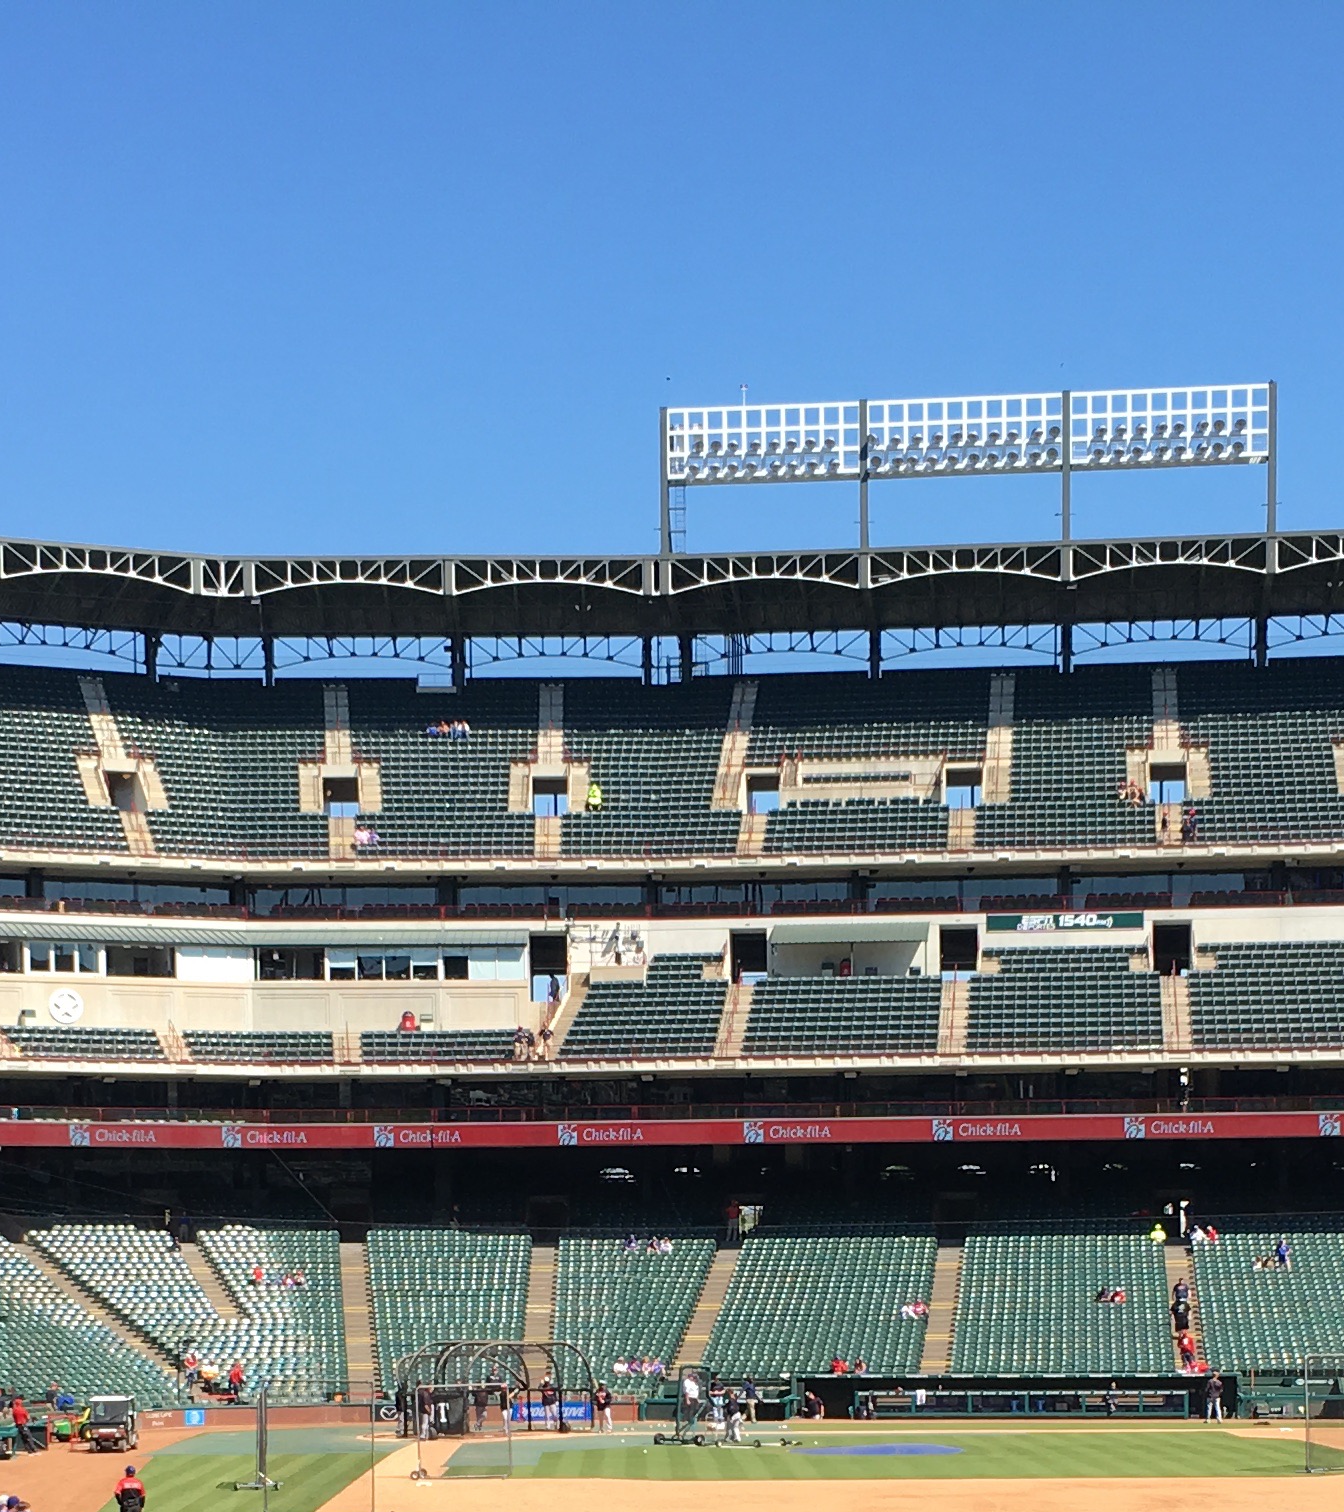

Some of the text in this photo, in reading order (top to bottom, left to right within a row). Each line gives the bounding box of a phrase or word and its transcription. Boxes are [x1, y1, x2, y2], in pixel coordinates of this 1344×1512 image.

[1058, 914, 1097, 927] 1540
[769, 1125, 831, 1139] Chick-fil-A
[958, 1122, 1021, 1137] Chick-fil-A
[1150, 1119, 1214, 1134] Chick-fil-A
[95, 1128, 156, 1142] Chick-fil-A
[246, 1129, 307, 1144] Chick-fil-A
[399, 1129, 461, 1143] Chick-fil-A
[583, 1127, 643, 1142] Chick-fil-A
